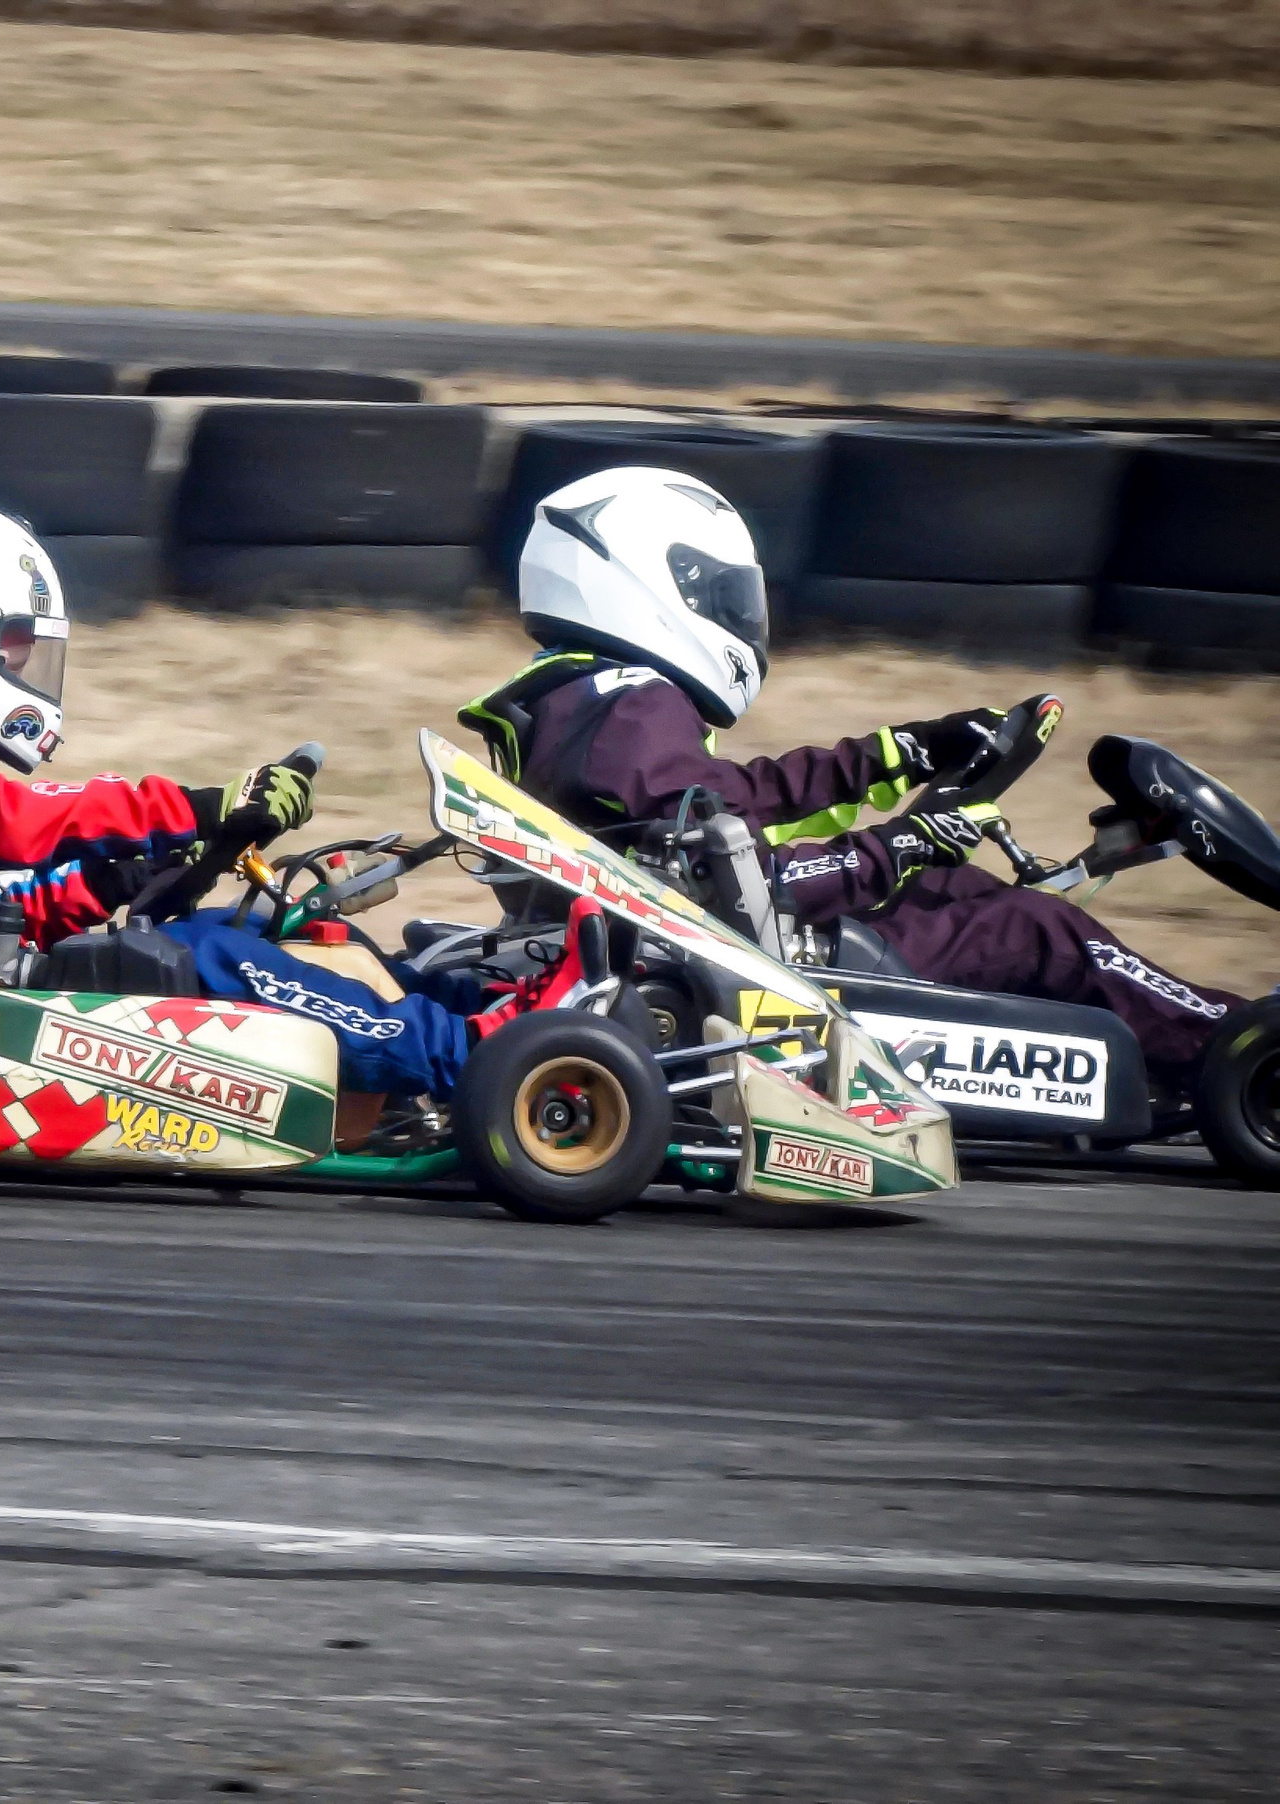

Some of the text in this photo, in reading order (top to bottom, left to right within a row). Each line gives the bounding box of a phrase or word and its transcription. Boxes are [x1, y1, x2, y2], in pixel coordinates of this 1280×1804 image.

[51, 1022, 279, 1114] TONY KART
[900, 1031, 1097, 1084] LIARD
[930, 1075, 1092, 1107] RACING TEAM
[107, 1094, 220, 1152] WARD
[774, 1141, 820, 1169] TONY
